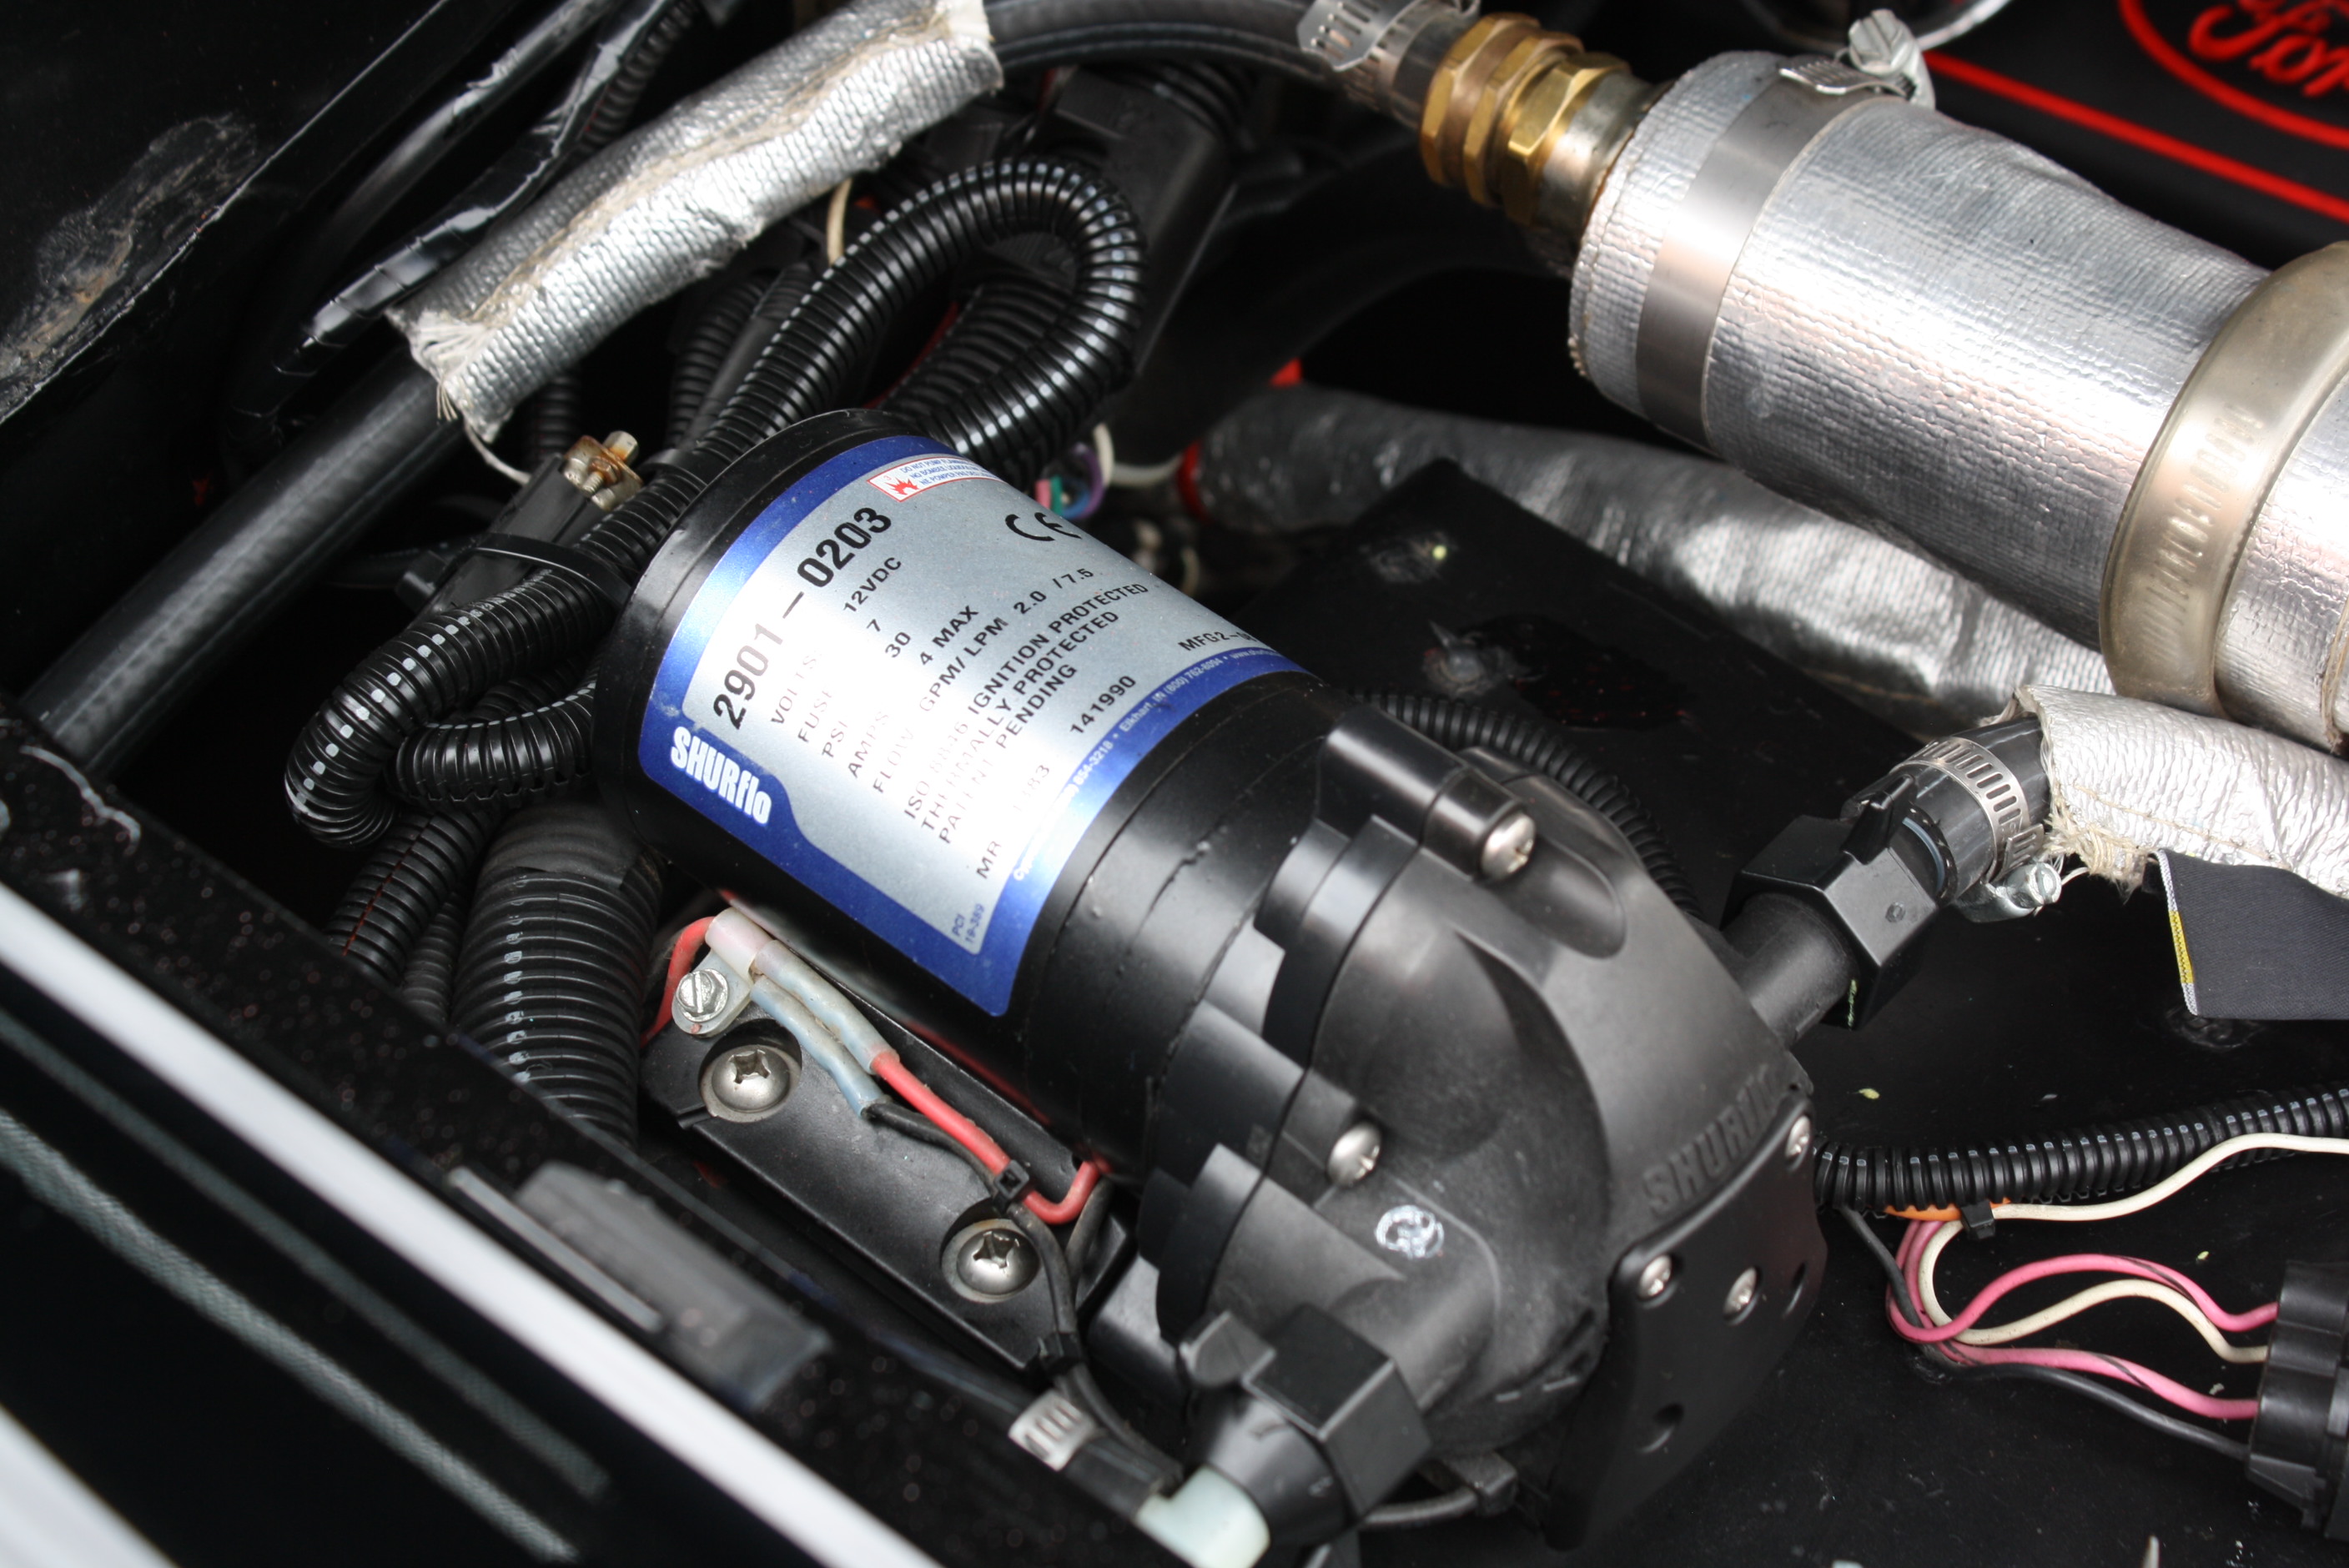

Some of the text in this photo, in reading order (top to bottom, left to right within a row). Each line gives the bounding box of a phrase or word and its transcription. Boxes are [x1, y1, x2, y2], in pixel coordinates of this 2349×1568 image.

[2188, 0, 2349, 96] For
[843, 556, 902, 612] 12VDC
[866, 618, 882, 632] 7
[822, 631, 911, 758] PSI 30
[848, 605, 979, 779] AMPS 4 MAX
[873, 727, 915, 794] FLOW
[1013, 590, 1048, 615] 2.0
[903, 780, 930, 820] ISO
[968, 633, 1050, 715] IGNITION
[1048, 583, 1149, 635] PROTECTED
[1013, 611, 1119, 696] PROTECTED
[1152, 691, 1168, 703] IN
[995, 664, 1078, 750] PENDING
[976, 840, 1003, 880] MR
[1069, 675, 1137, 735] 141990
